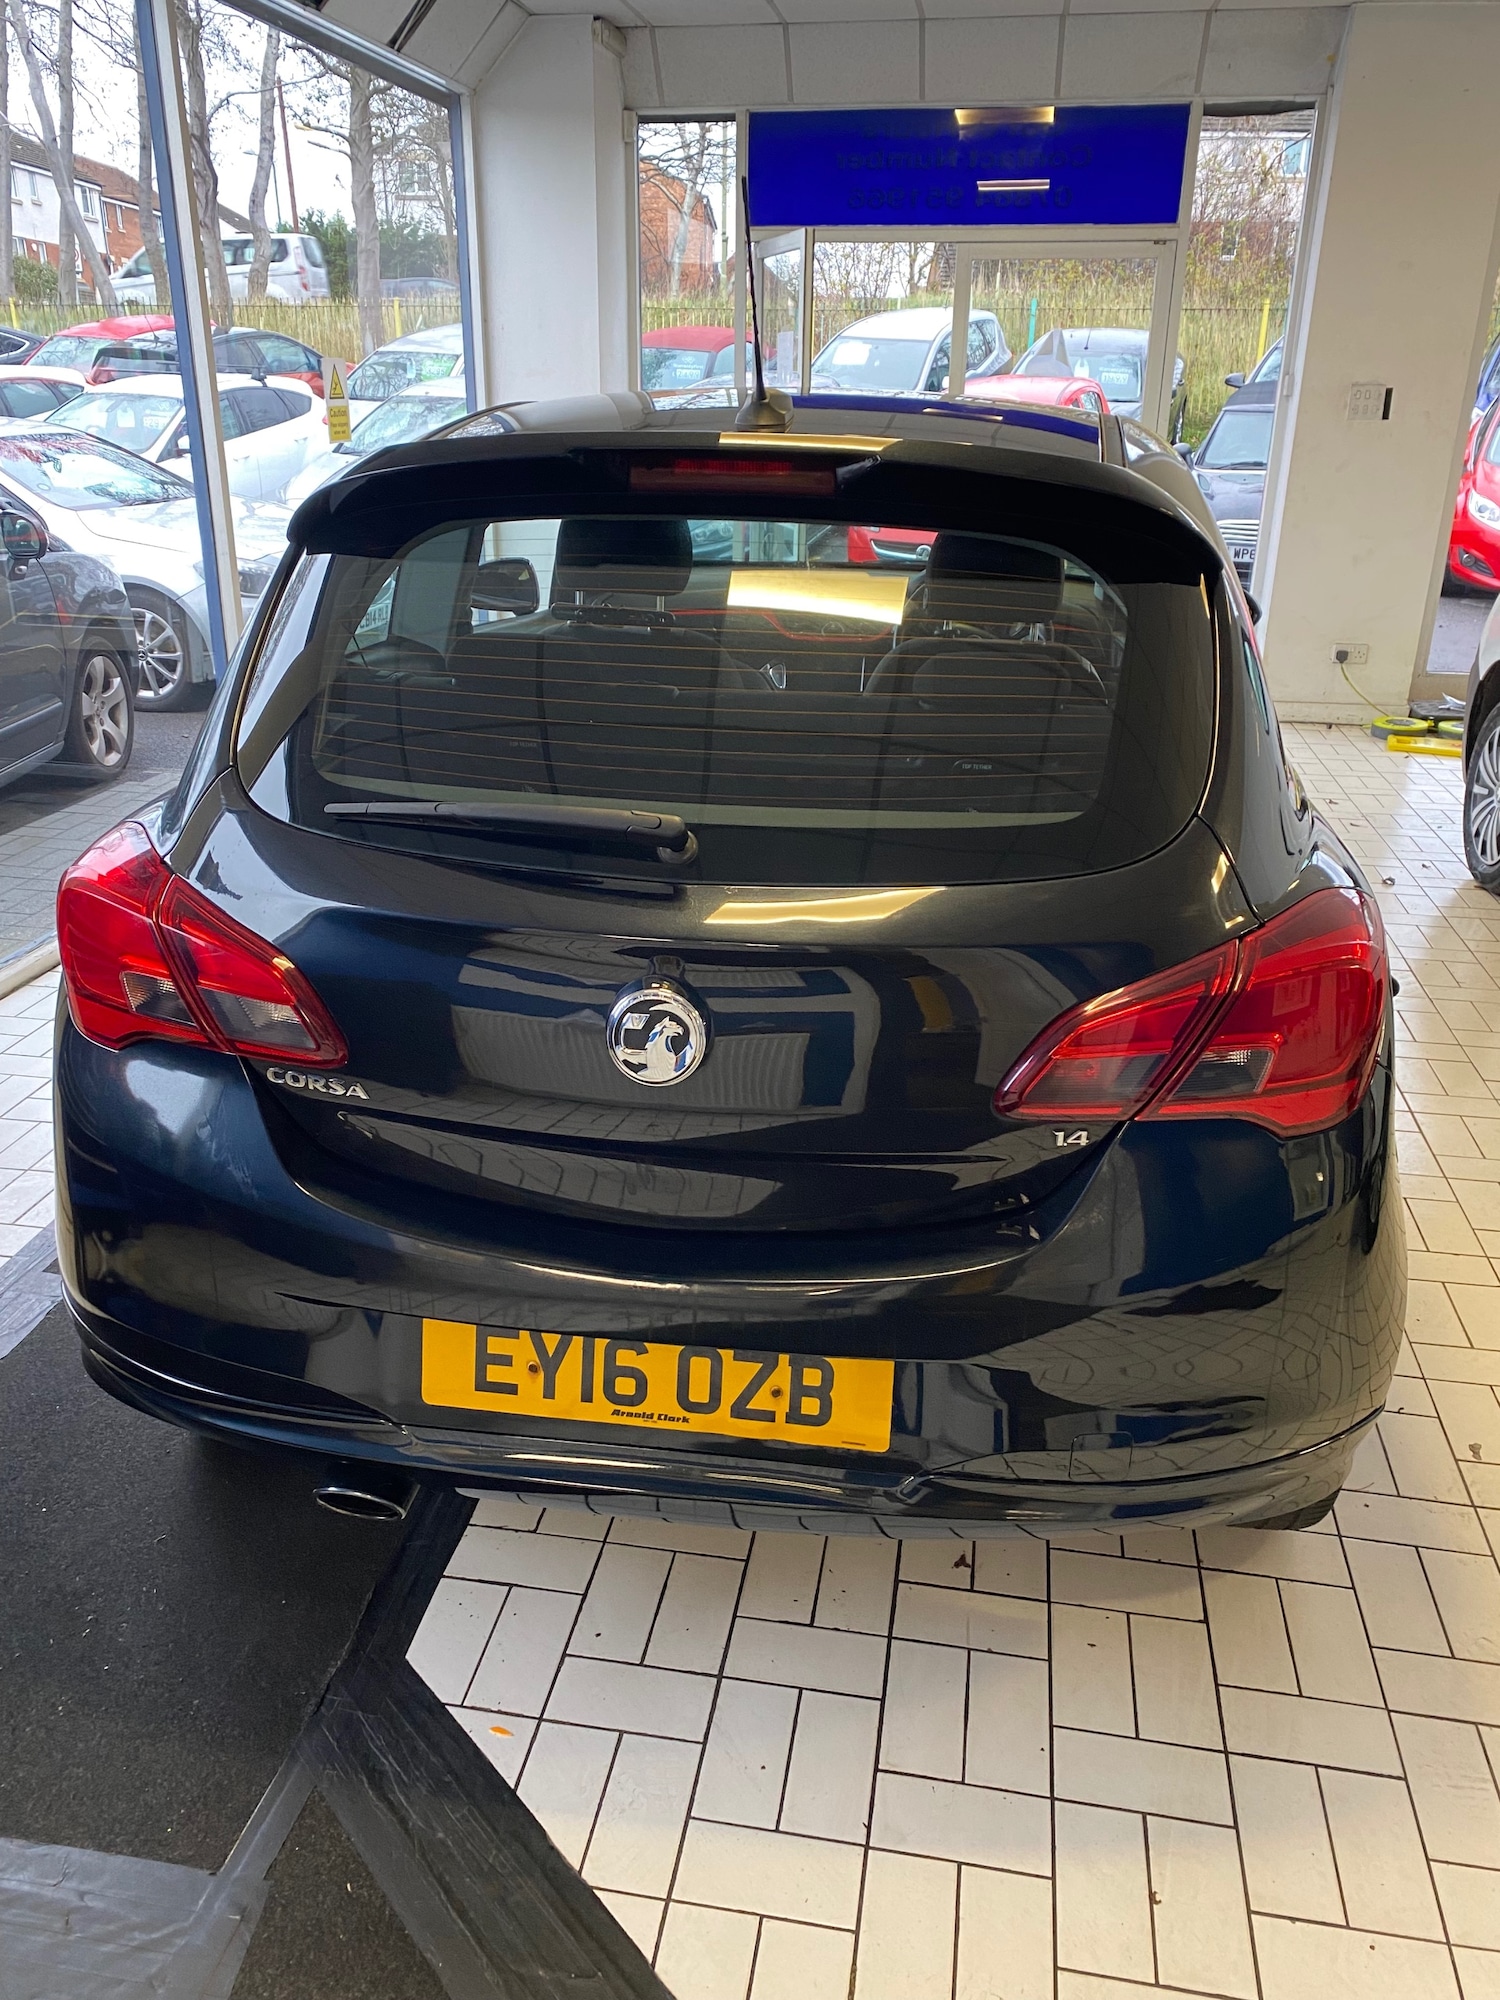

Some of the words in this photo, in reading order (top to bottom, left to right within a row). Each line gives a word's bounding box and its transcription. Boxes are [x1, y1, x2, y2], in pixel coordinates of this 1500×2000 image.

[329, 408, 348, 418] Caution
[266, 1067, 370, 1099] CORSA
[1052, 1130, 1090, 1147] 1.4
[474, 1325, 648, 1408] EY16
[677, 1346, 835, 1427] OZB
[611, 1409, 655, 1420] Arnold
[657, 1413, 691, 1424] Clark
